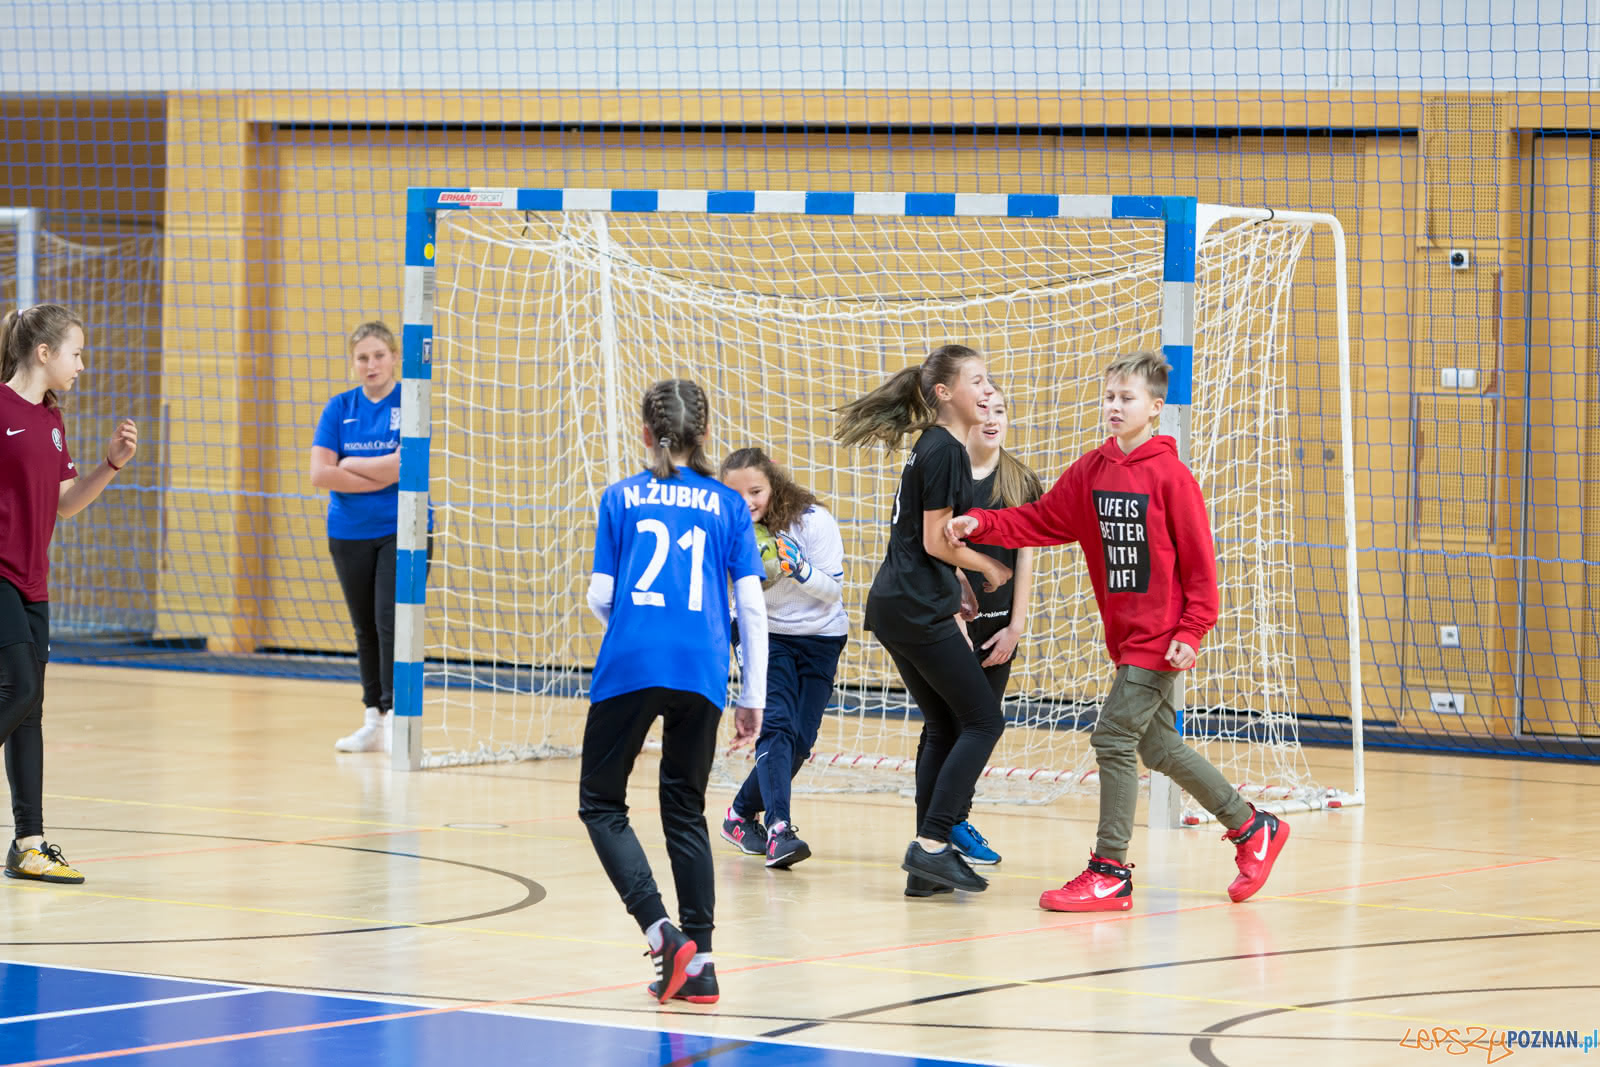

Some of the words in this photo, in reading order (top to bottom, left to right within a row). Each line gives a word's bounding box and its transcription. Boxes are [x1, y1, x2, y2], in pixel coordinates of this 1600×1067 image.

[440, 193, 478, 202] ERHARD
[479, 193, 501, 202] SPORT
[623, 478, 720, 516] N.ŻUBKA
[1098, 497, 1123, 517] LIFE
[1125, 499, 1139, 518] IS
[1099, 520, 1145, 542] BETTER
[631, 518, 707, 611] 21
